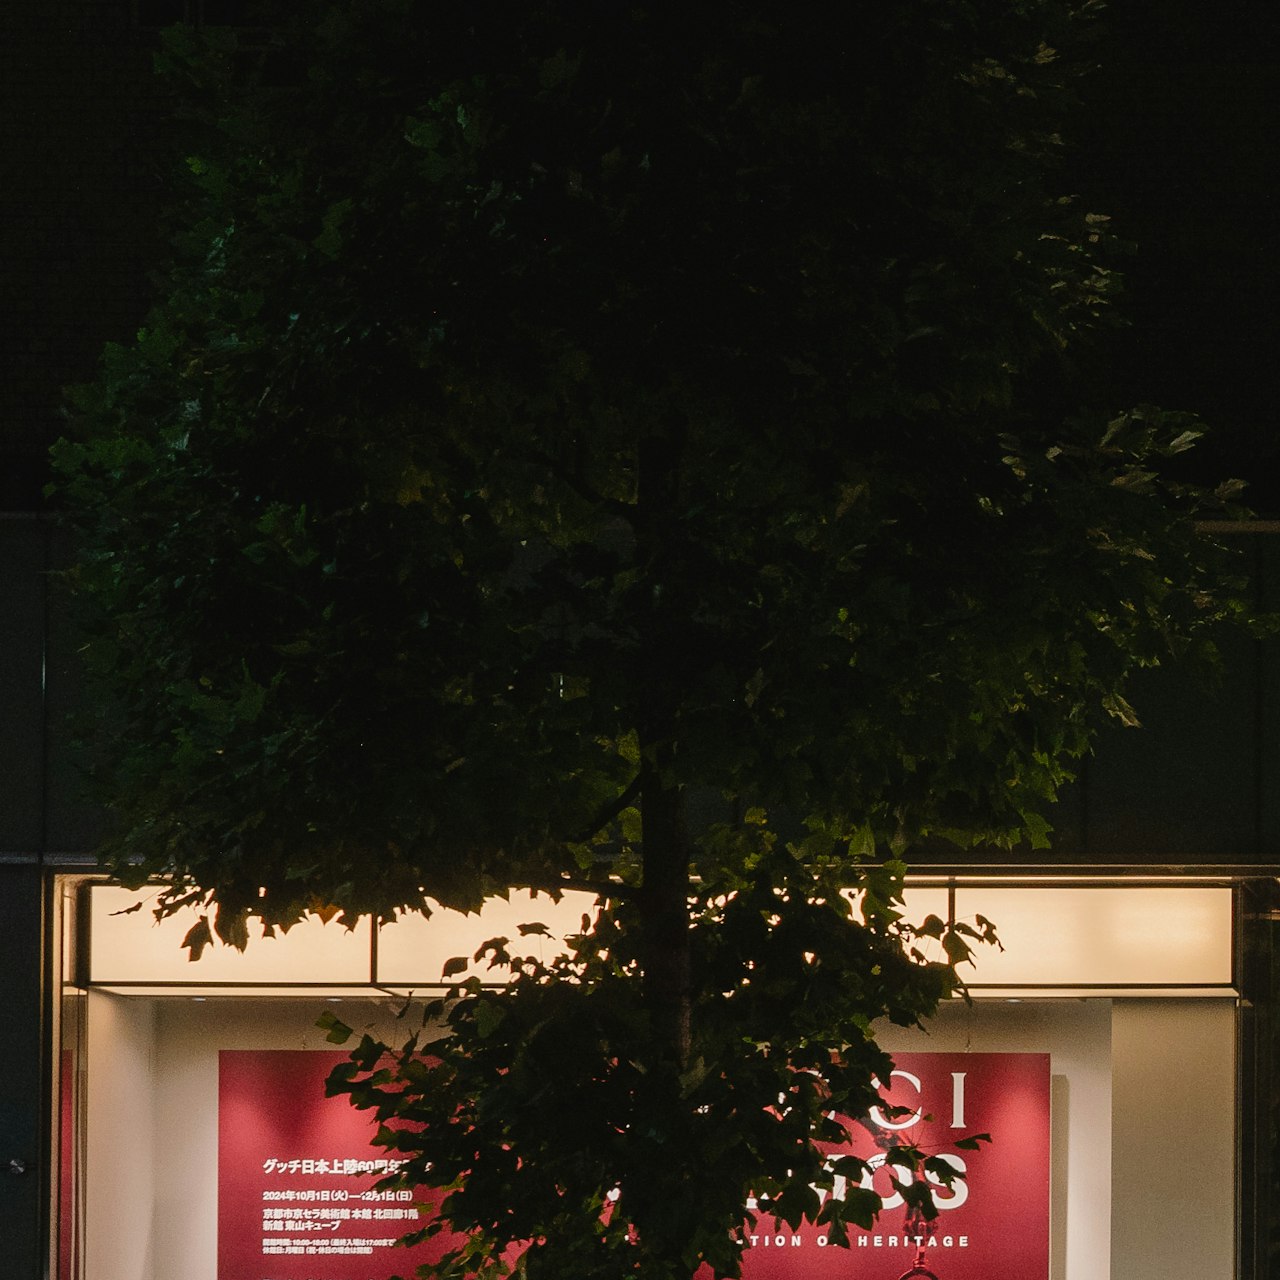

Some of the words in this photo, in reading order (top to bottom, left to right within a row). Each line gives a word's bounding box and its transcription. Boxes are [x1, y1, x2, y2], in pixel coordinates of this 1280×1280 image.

[263, 1158, 433, 1176] グッチ日本上陸60周年
[352, 1208, 372, 1220] 本館
[263, 1220, 284, 1231] 新館
[285, 1220, 341, 1231] 東山キューブ
[858, 1236, 969, 1247] HERITAGE
